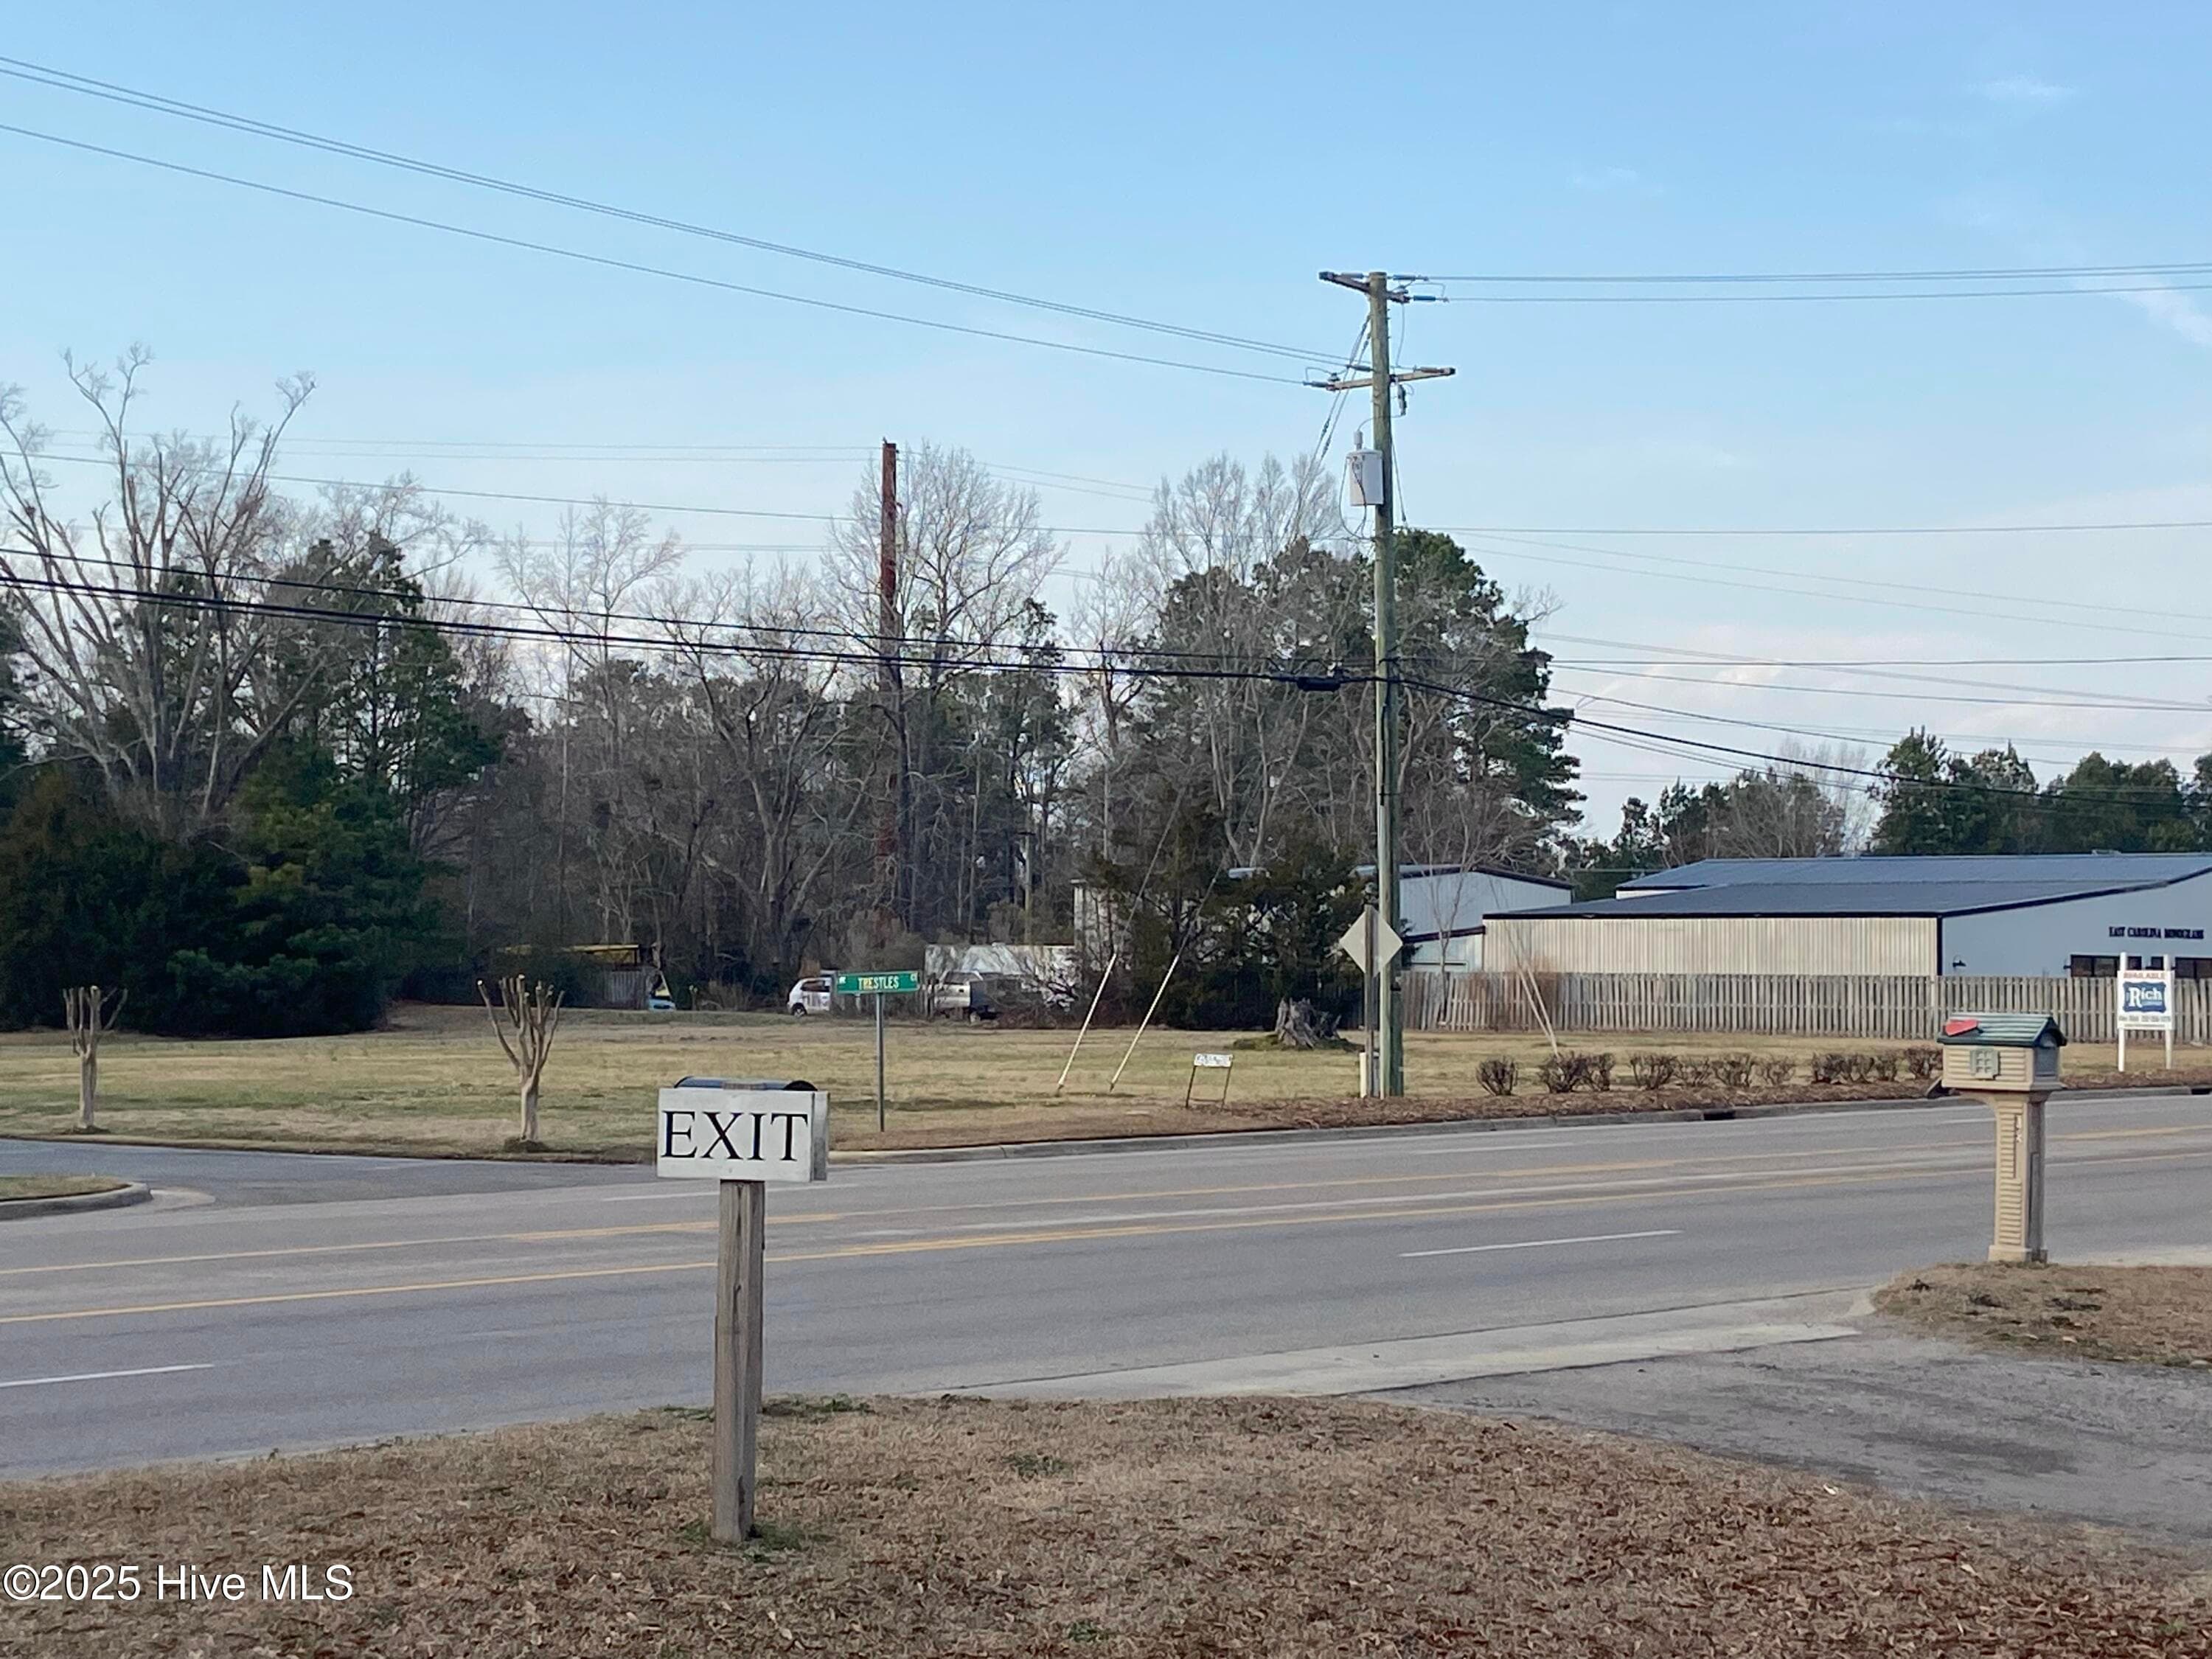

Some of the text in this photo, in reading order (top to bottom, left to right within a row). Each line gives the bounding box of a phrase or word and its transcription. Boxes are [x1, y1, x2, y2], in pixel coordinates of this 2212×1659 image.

[2109, 926, 2125, 937] EAST
[2127, 927, 2161, 938] CAROLINA
[858, 975, 900, 990] TRESTLES
[2128, 987, 2163, 1008] Rich
[660, 1110, 809, 1161] EXIT
